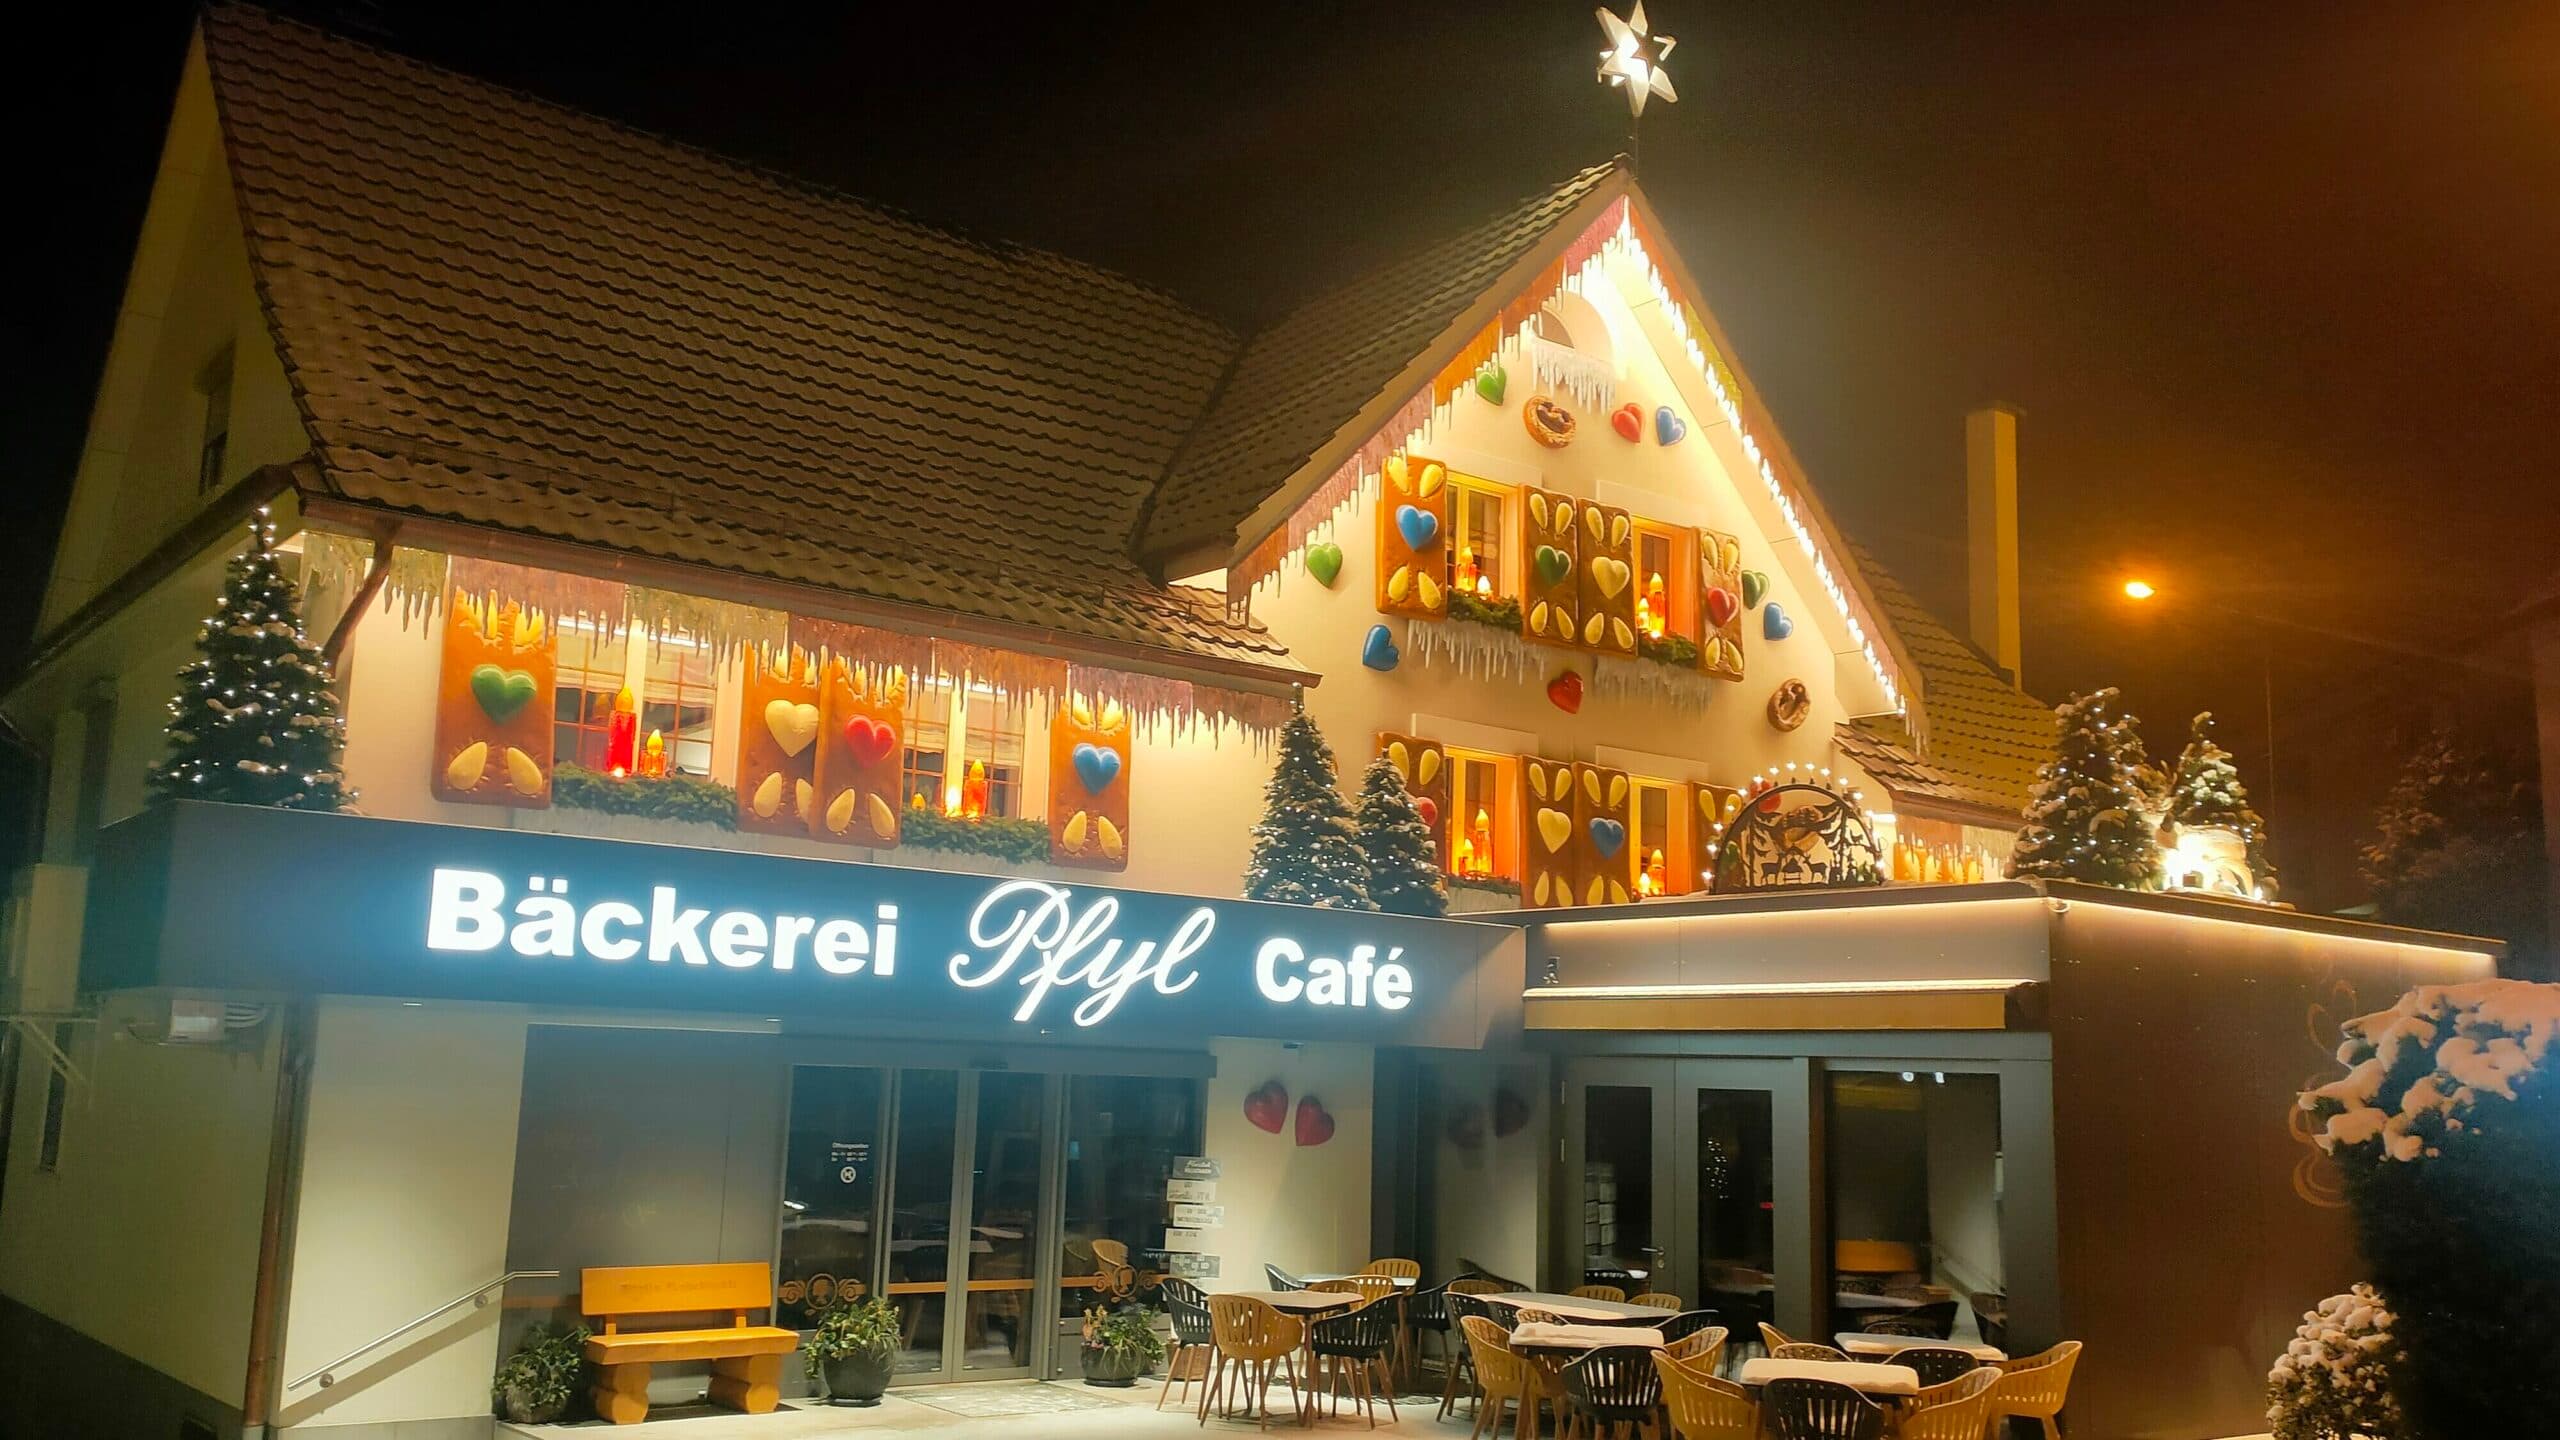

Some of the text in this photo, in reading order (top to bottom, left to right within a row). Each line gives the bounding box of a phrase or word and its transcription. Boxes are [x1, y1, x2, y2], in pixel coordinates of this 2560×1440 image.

[428, 869, 1413, 1027] Bäckerei Pfyl Café
